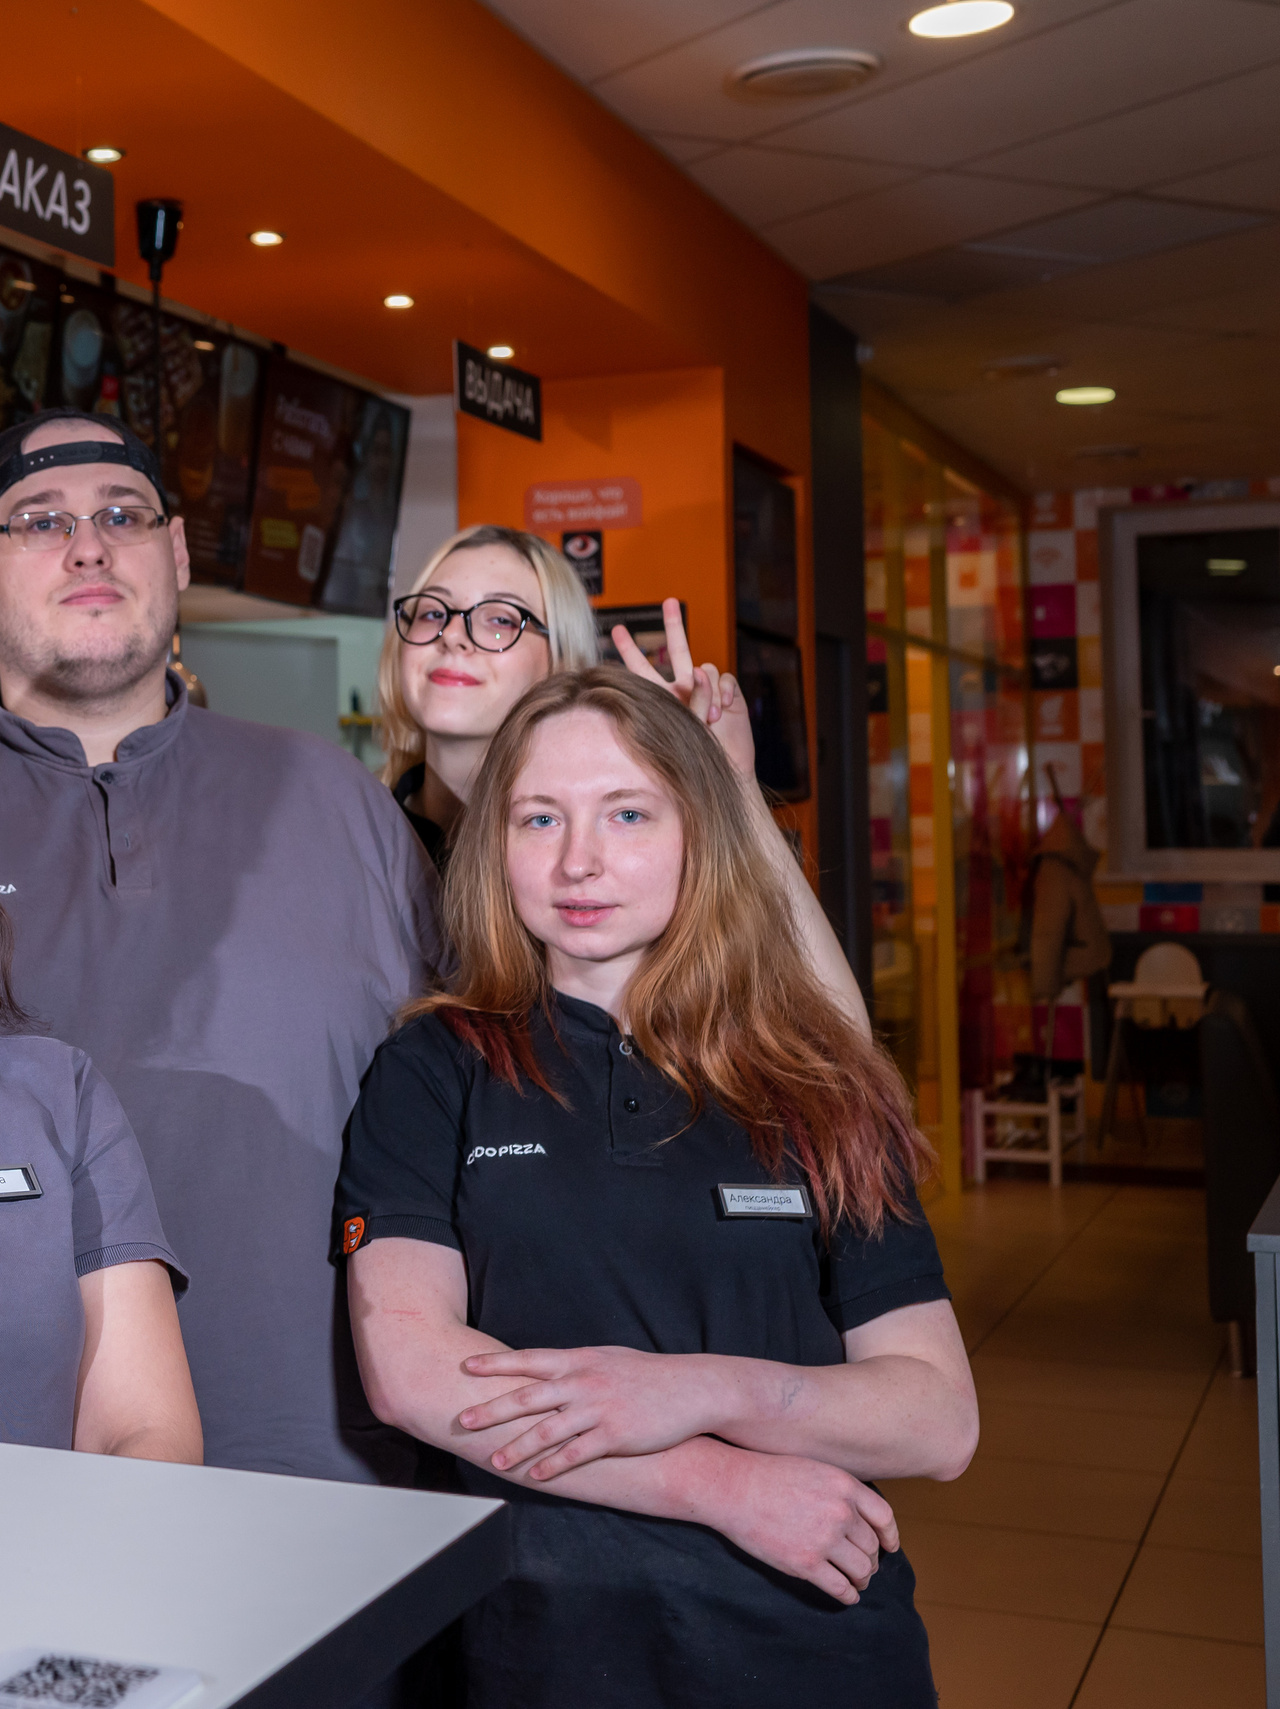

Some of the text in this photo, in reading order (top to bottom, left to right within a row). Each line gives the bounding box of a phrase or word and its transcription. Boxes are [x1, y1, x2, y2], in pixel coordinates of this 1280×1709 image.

[464, 358, 535, 425] ВЫДАЧА
[467, 1143, 548, 1165] ODO PIZZA
[729, 1193, 792, 1206] Александра
